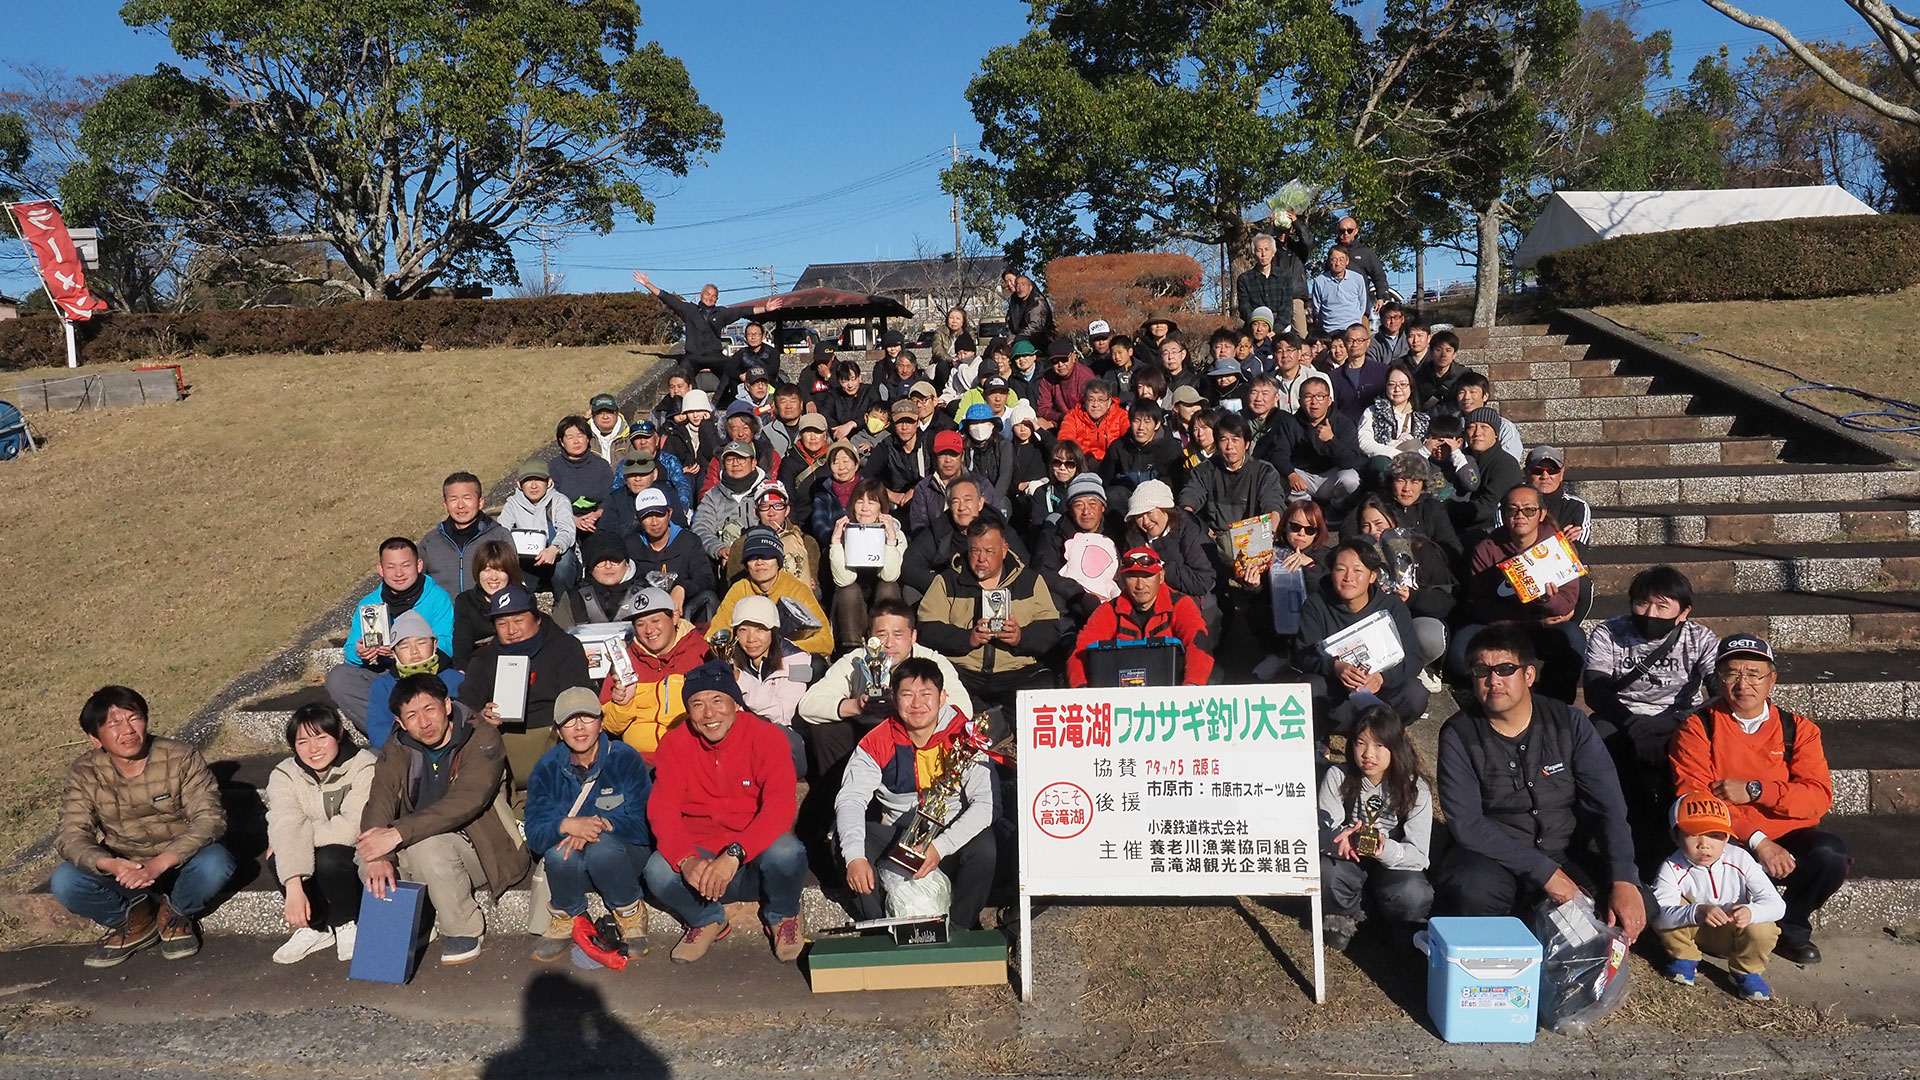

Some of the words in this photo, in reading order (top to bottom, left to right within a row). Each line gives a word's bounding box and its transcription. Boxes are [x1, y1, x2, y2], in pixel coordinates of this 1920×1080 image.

[27, 208, 92, 319] ラーメン
[1145, 758, 1184, 776] アタック5
[1192, 758, 1220, 776] 茂原店
[1040, 789, 1082, 807] ようこそ
[1040, 808, 1085, 826] 高滝湖
[1148, 819, 1249, 836] 小湊鉄道株式会社
[1149, 838, 1309, 856] 養老川漁業協同組合
[1150, 856, 1310, 874] 高滝湖観光企業組合
